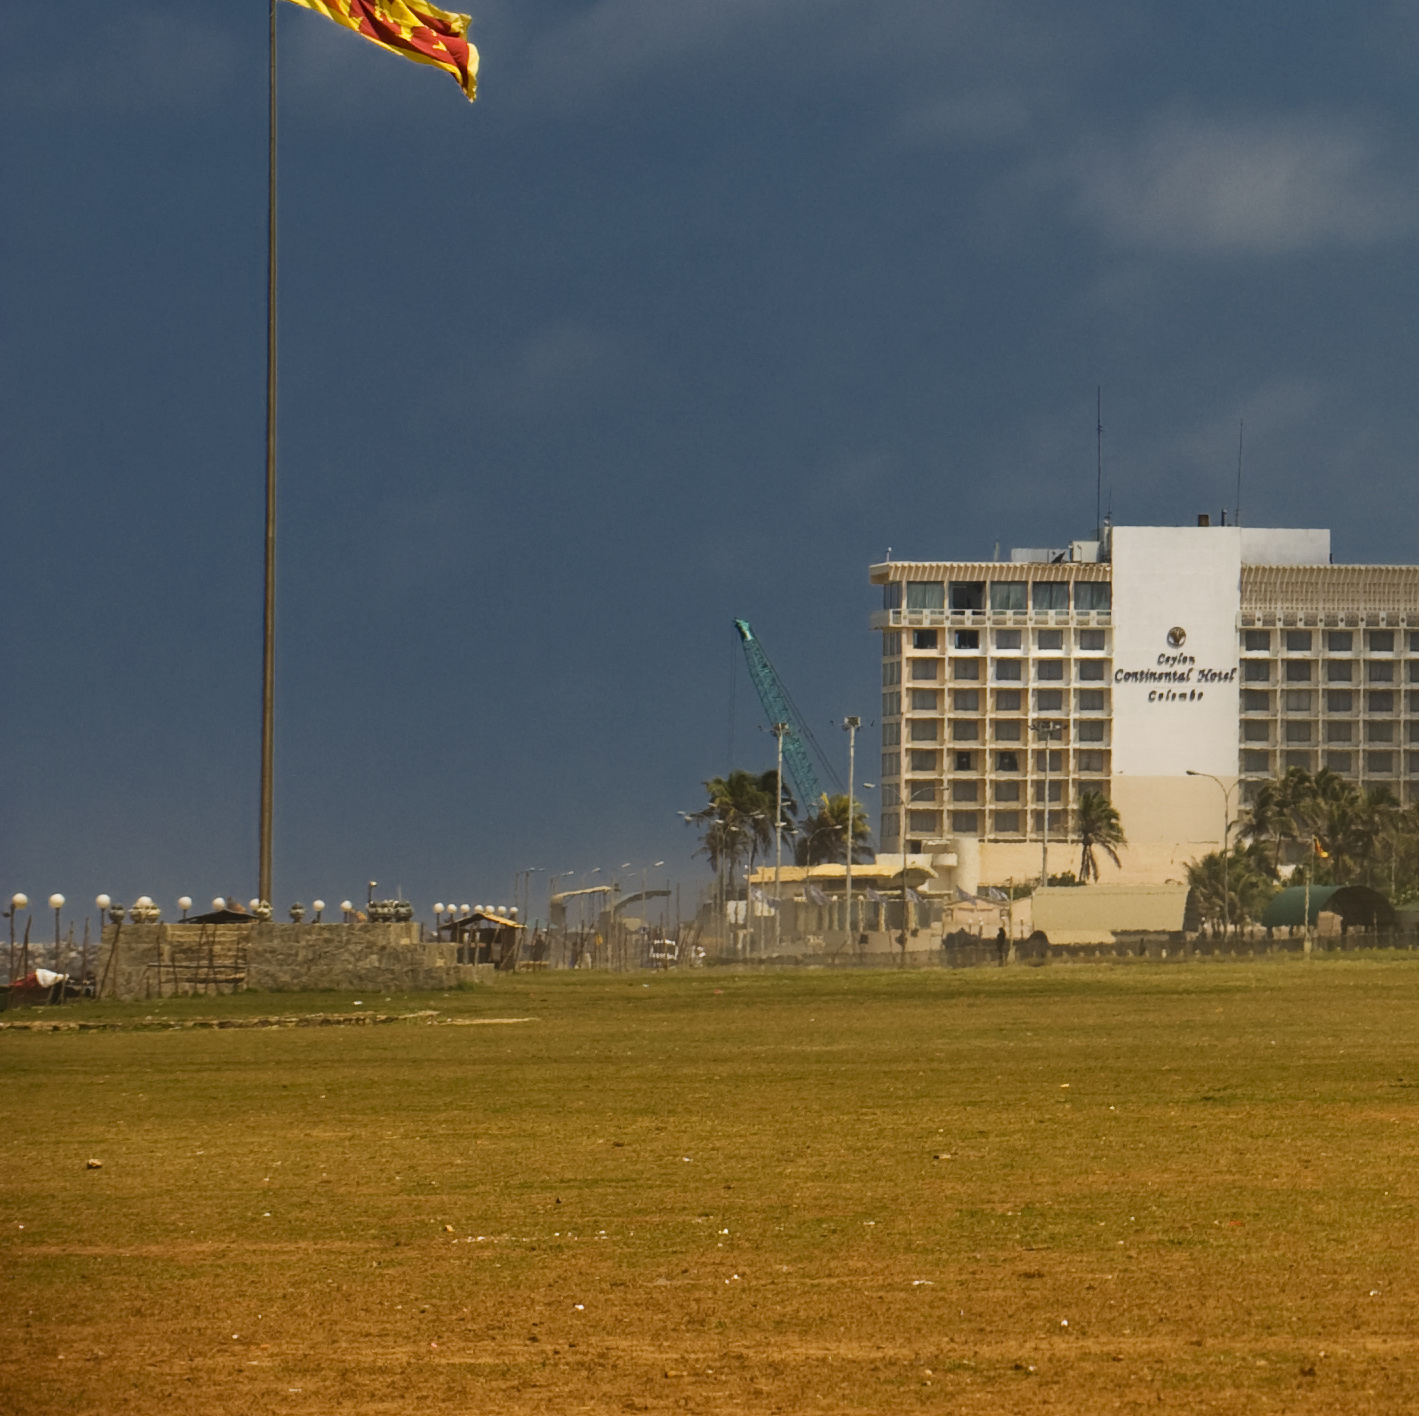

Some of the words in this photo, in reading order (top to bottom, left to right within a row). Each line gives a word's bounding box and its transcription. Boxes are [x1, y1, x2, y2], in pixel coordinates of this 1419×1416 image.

[1157, 653, 1196, 667] Ceylon
[1115, 668, 1194, 683] Continental
[1197, 668, 1238, 683] Hotel
[1148, 689, 1204, 702] Colombo
